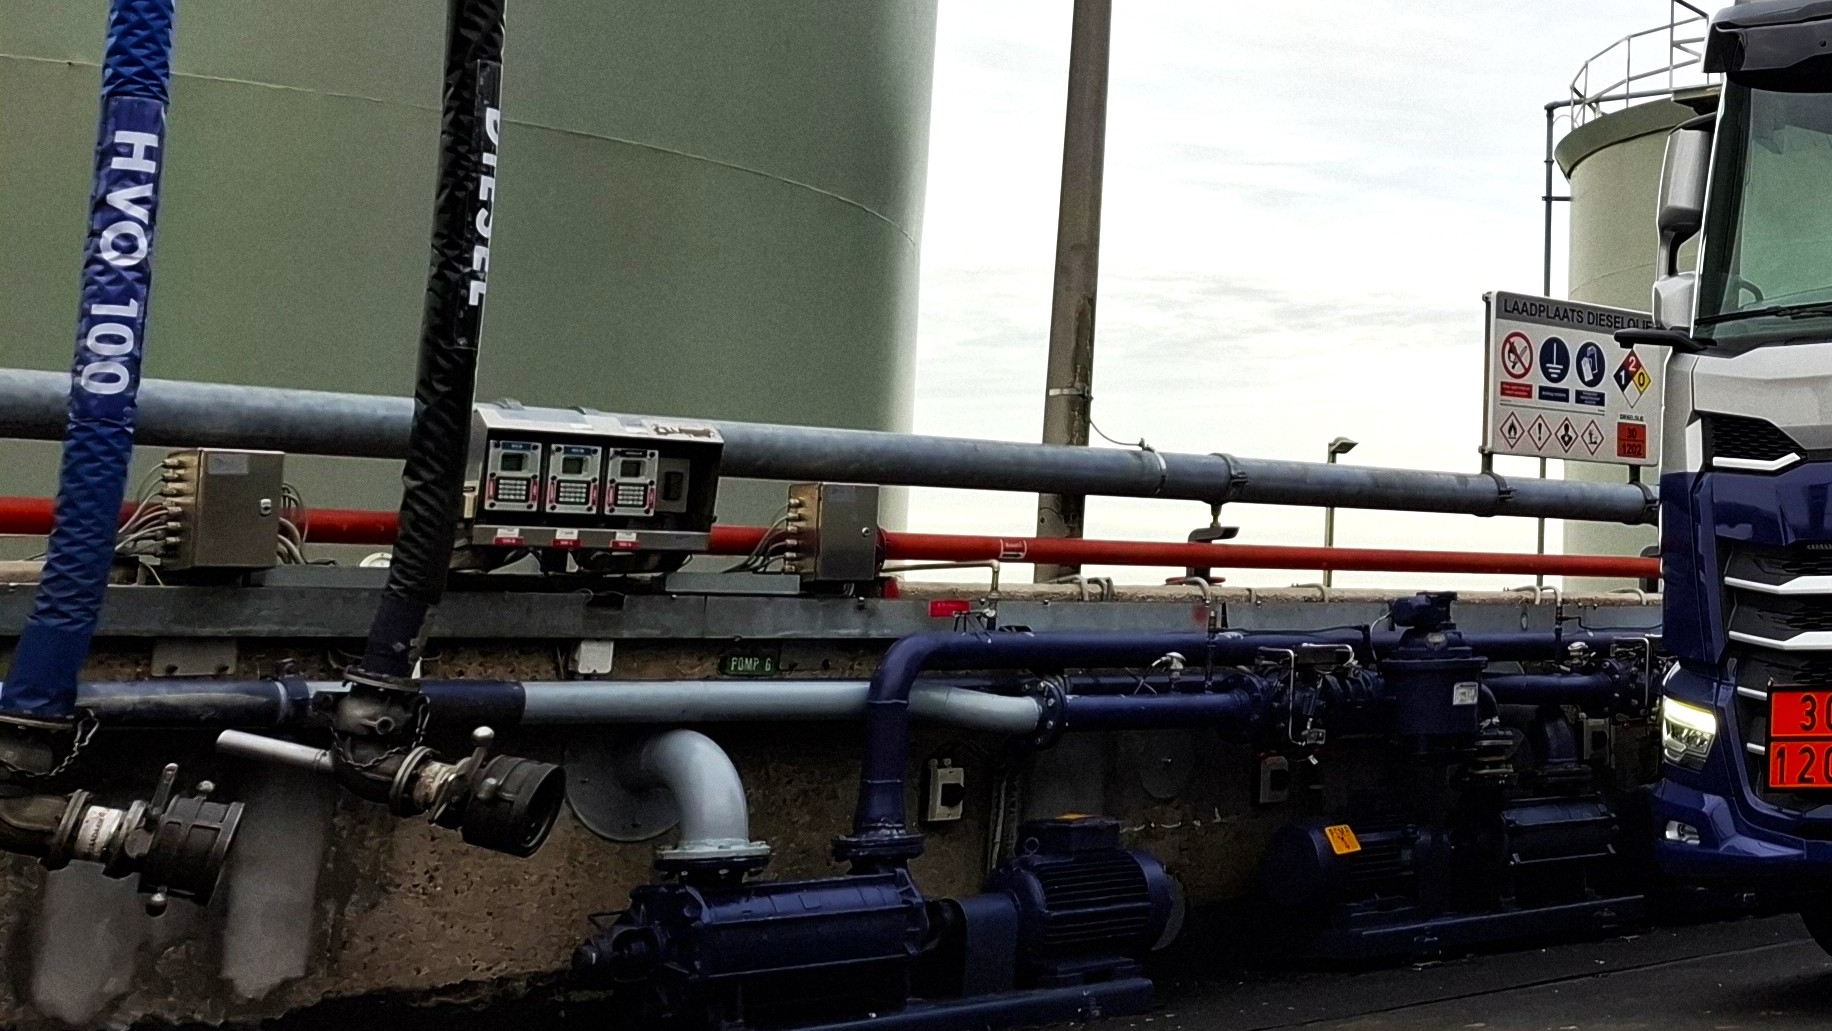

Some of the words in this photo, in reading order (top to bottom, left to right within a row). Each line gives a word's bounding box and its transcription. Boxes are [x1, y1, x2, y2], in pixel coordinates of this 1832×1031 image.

[100, 130, 159, 267] HVO
[1504, 298, 1584, 324] LAADPLAATS
[80, 297, 138, 395] 100
[1628, 356, 1637, 371] 2
[1619, 369, 1626, 384] 1
[1637, 373, 1645, 387] 0
[1627, 427, 1637, 439] 30
[1621, 443, 1642, 456] 1202
